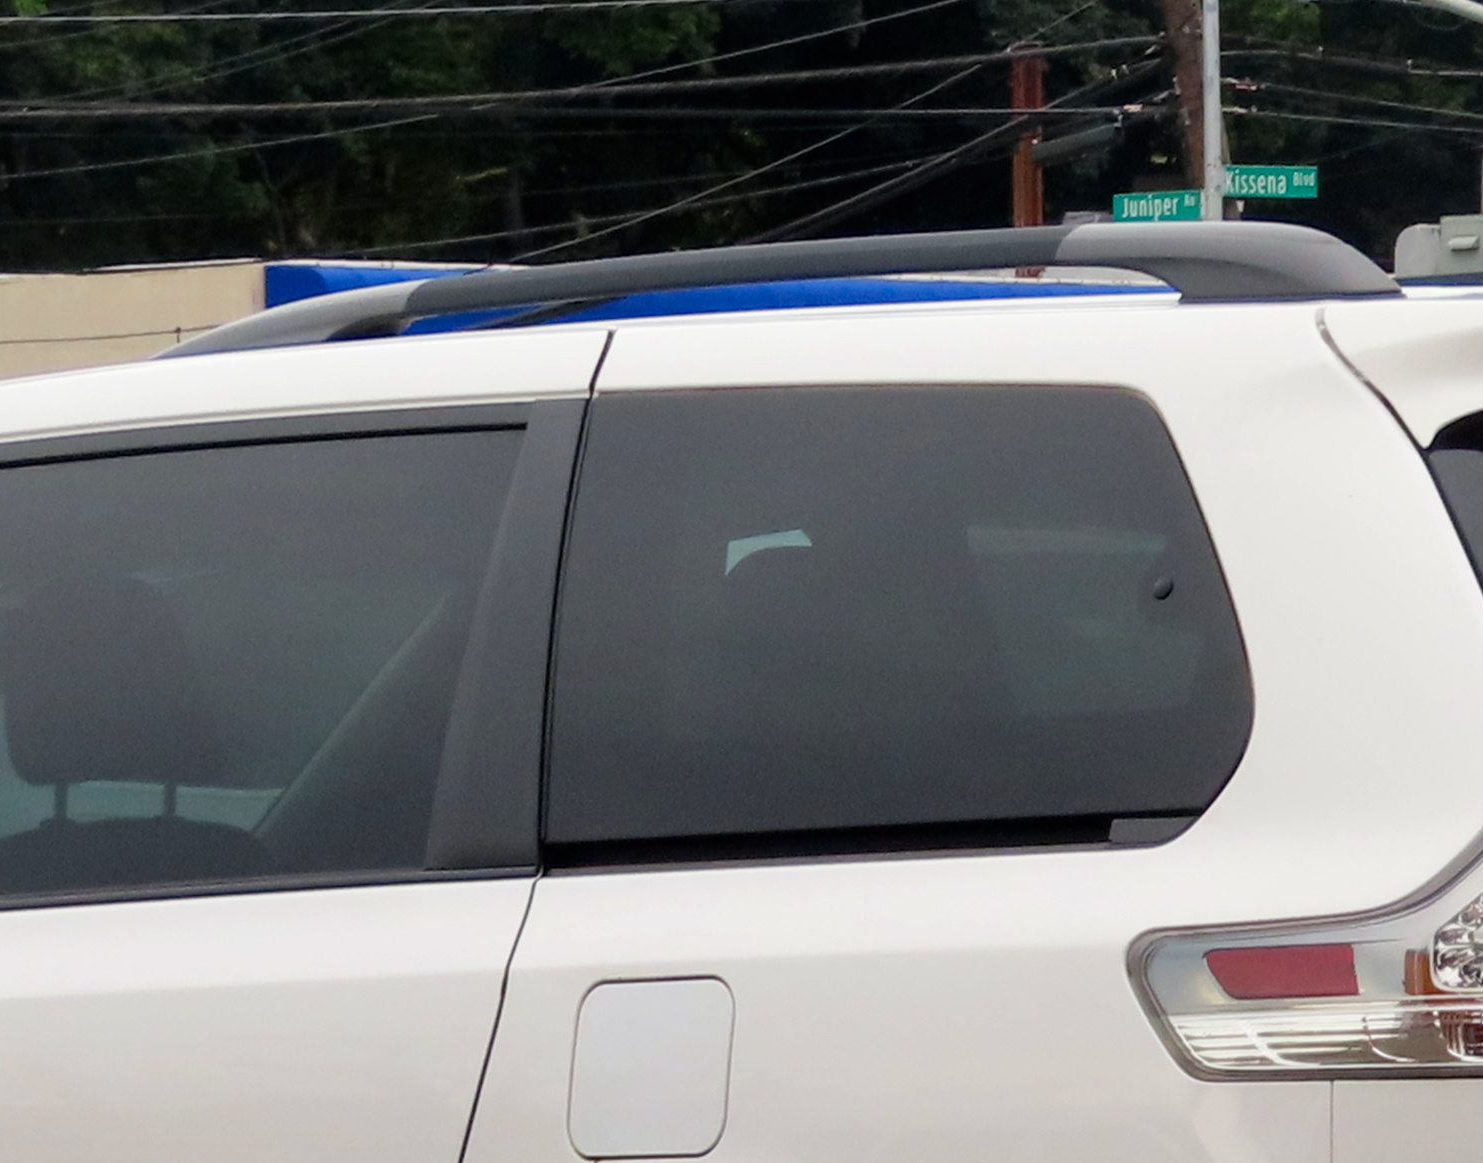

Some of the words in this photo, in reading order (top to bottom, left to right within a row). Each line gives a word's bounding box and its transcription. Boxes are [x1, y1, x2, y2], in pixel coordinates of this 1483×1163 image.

[1225, 169, 1287, 194] Kissena
[1293, 171, 1316, 186] Blvd
[1122, 194, 1179, 222] Juniper
